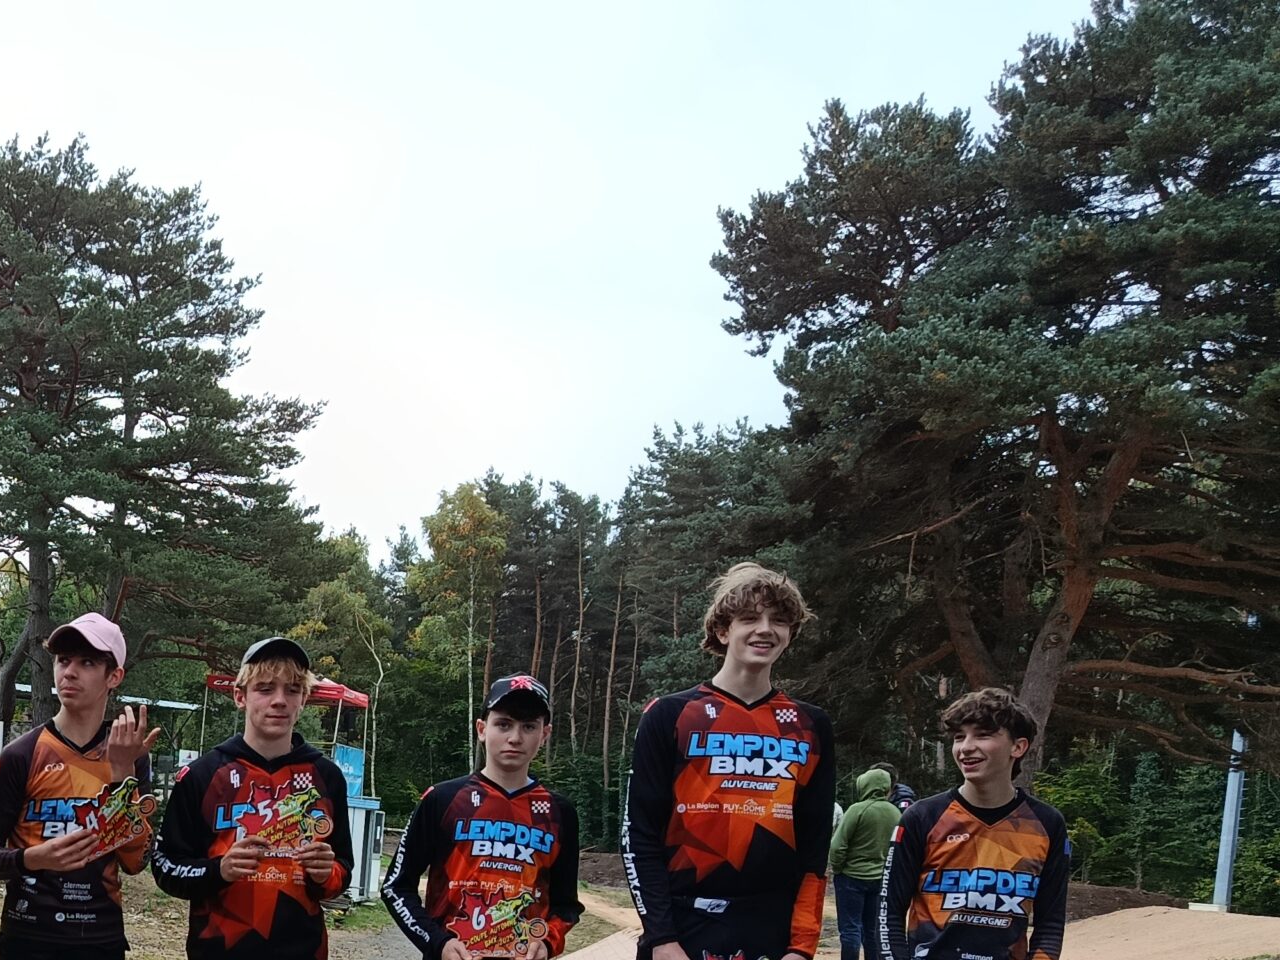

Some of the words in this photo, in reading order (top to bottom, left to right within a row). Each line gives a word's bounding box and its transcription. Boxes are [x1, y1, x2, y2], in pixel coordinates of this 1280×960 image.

[687, 732, 810, 765] LEMPDES
[709, 755, 795, 779] BMX
[721, 780, 778, 791] AUVERGNE
[257, 799, 273, 827] 5
[455, 819, 554, 853] LEMPDES
[471, 841, 535, 865] BMX
[923, 869, 1040, 897] LEMPDES
[942, 892, 1025, 914] BMX
[472, 906, 486, 931] 6
[951, 914, 1010, 927] AUVERGNE
[471, 930, 488, 945] COUPE
